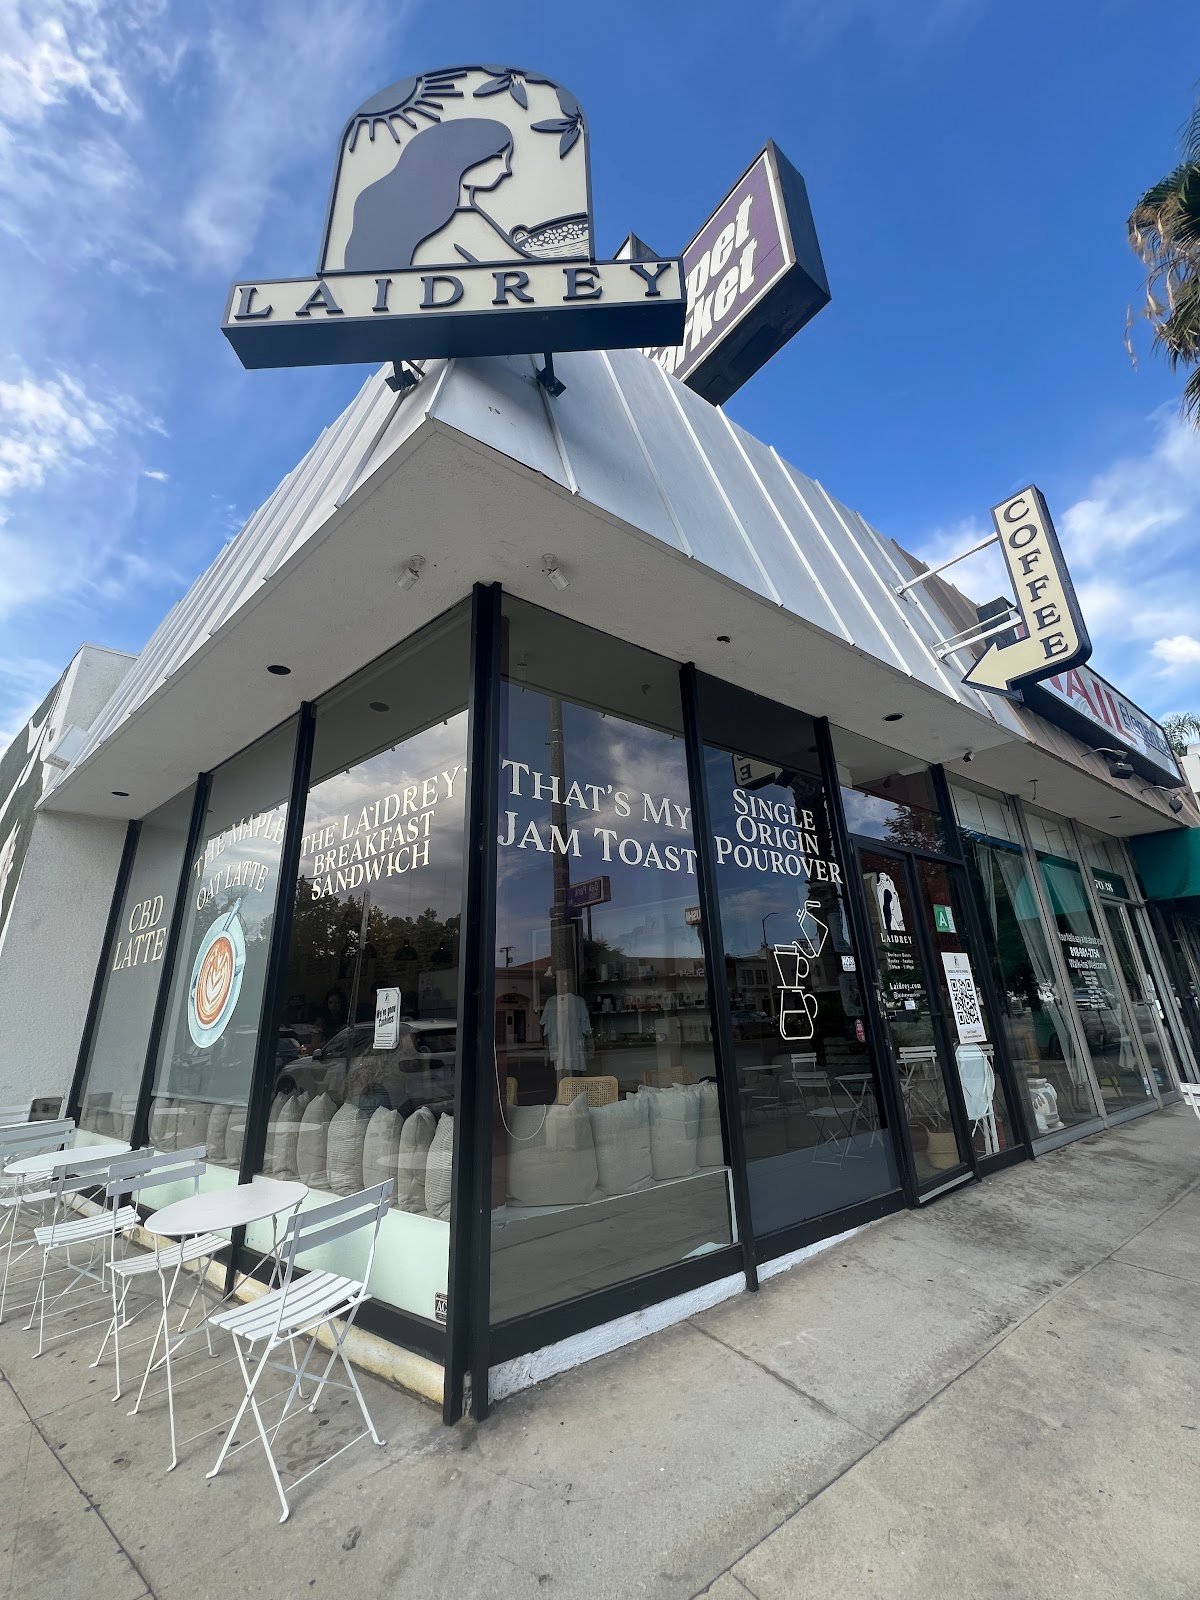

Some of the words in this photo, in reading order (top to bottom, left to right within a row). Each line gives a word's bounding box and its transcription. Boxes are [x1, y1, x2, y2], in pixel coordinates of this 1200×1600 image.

[233, 261, 672, 321] LAIDREY
[1003, 498, 1068, 659] COFFEE
[300, 828, 335, 858] THE
[341, 766, 462, 842] LAIDREY
[501, 759, 632, 818] THAT'S
[642, 792, 692, 830] MY
[731, 788, 817, 831] SINGLE
[194, 835, 224, 879] THE
[230, 808, 288, 846] MAPLE
[313, 810, 436, 877] BREAKFAST
[497, 810, 582, 858] JAM
[593, 827, 698, 875] TOAST
[713, 835, 844, 884] POUROVER
[735, 815, 820, 856] ORIGIN
[196, 870, 223, 912] OAT
[224, 860, 270, 893] LATTE
[311, 840, 431, 901] SANDWICH
[128, 894, 164, 934] CBD
[880, 932, 912, 944] LAIDREY
[939, 911, 948, 927] A
[112, 927, 167, 972] LATTE
